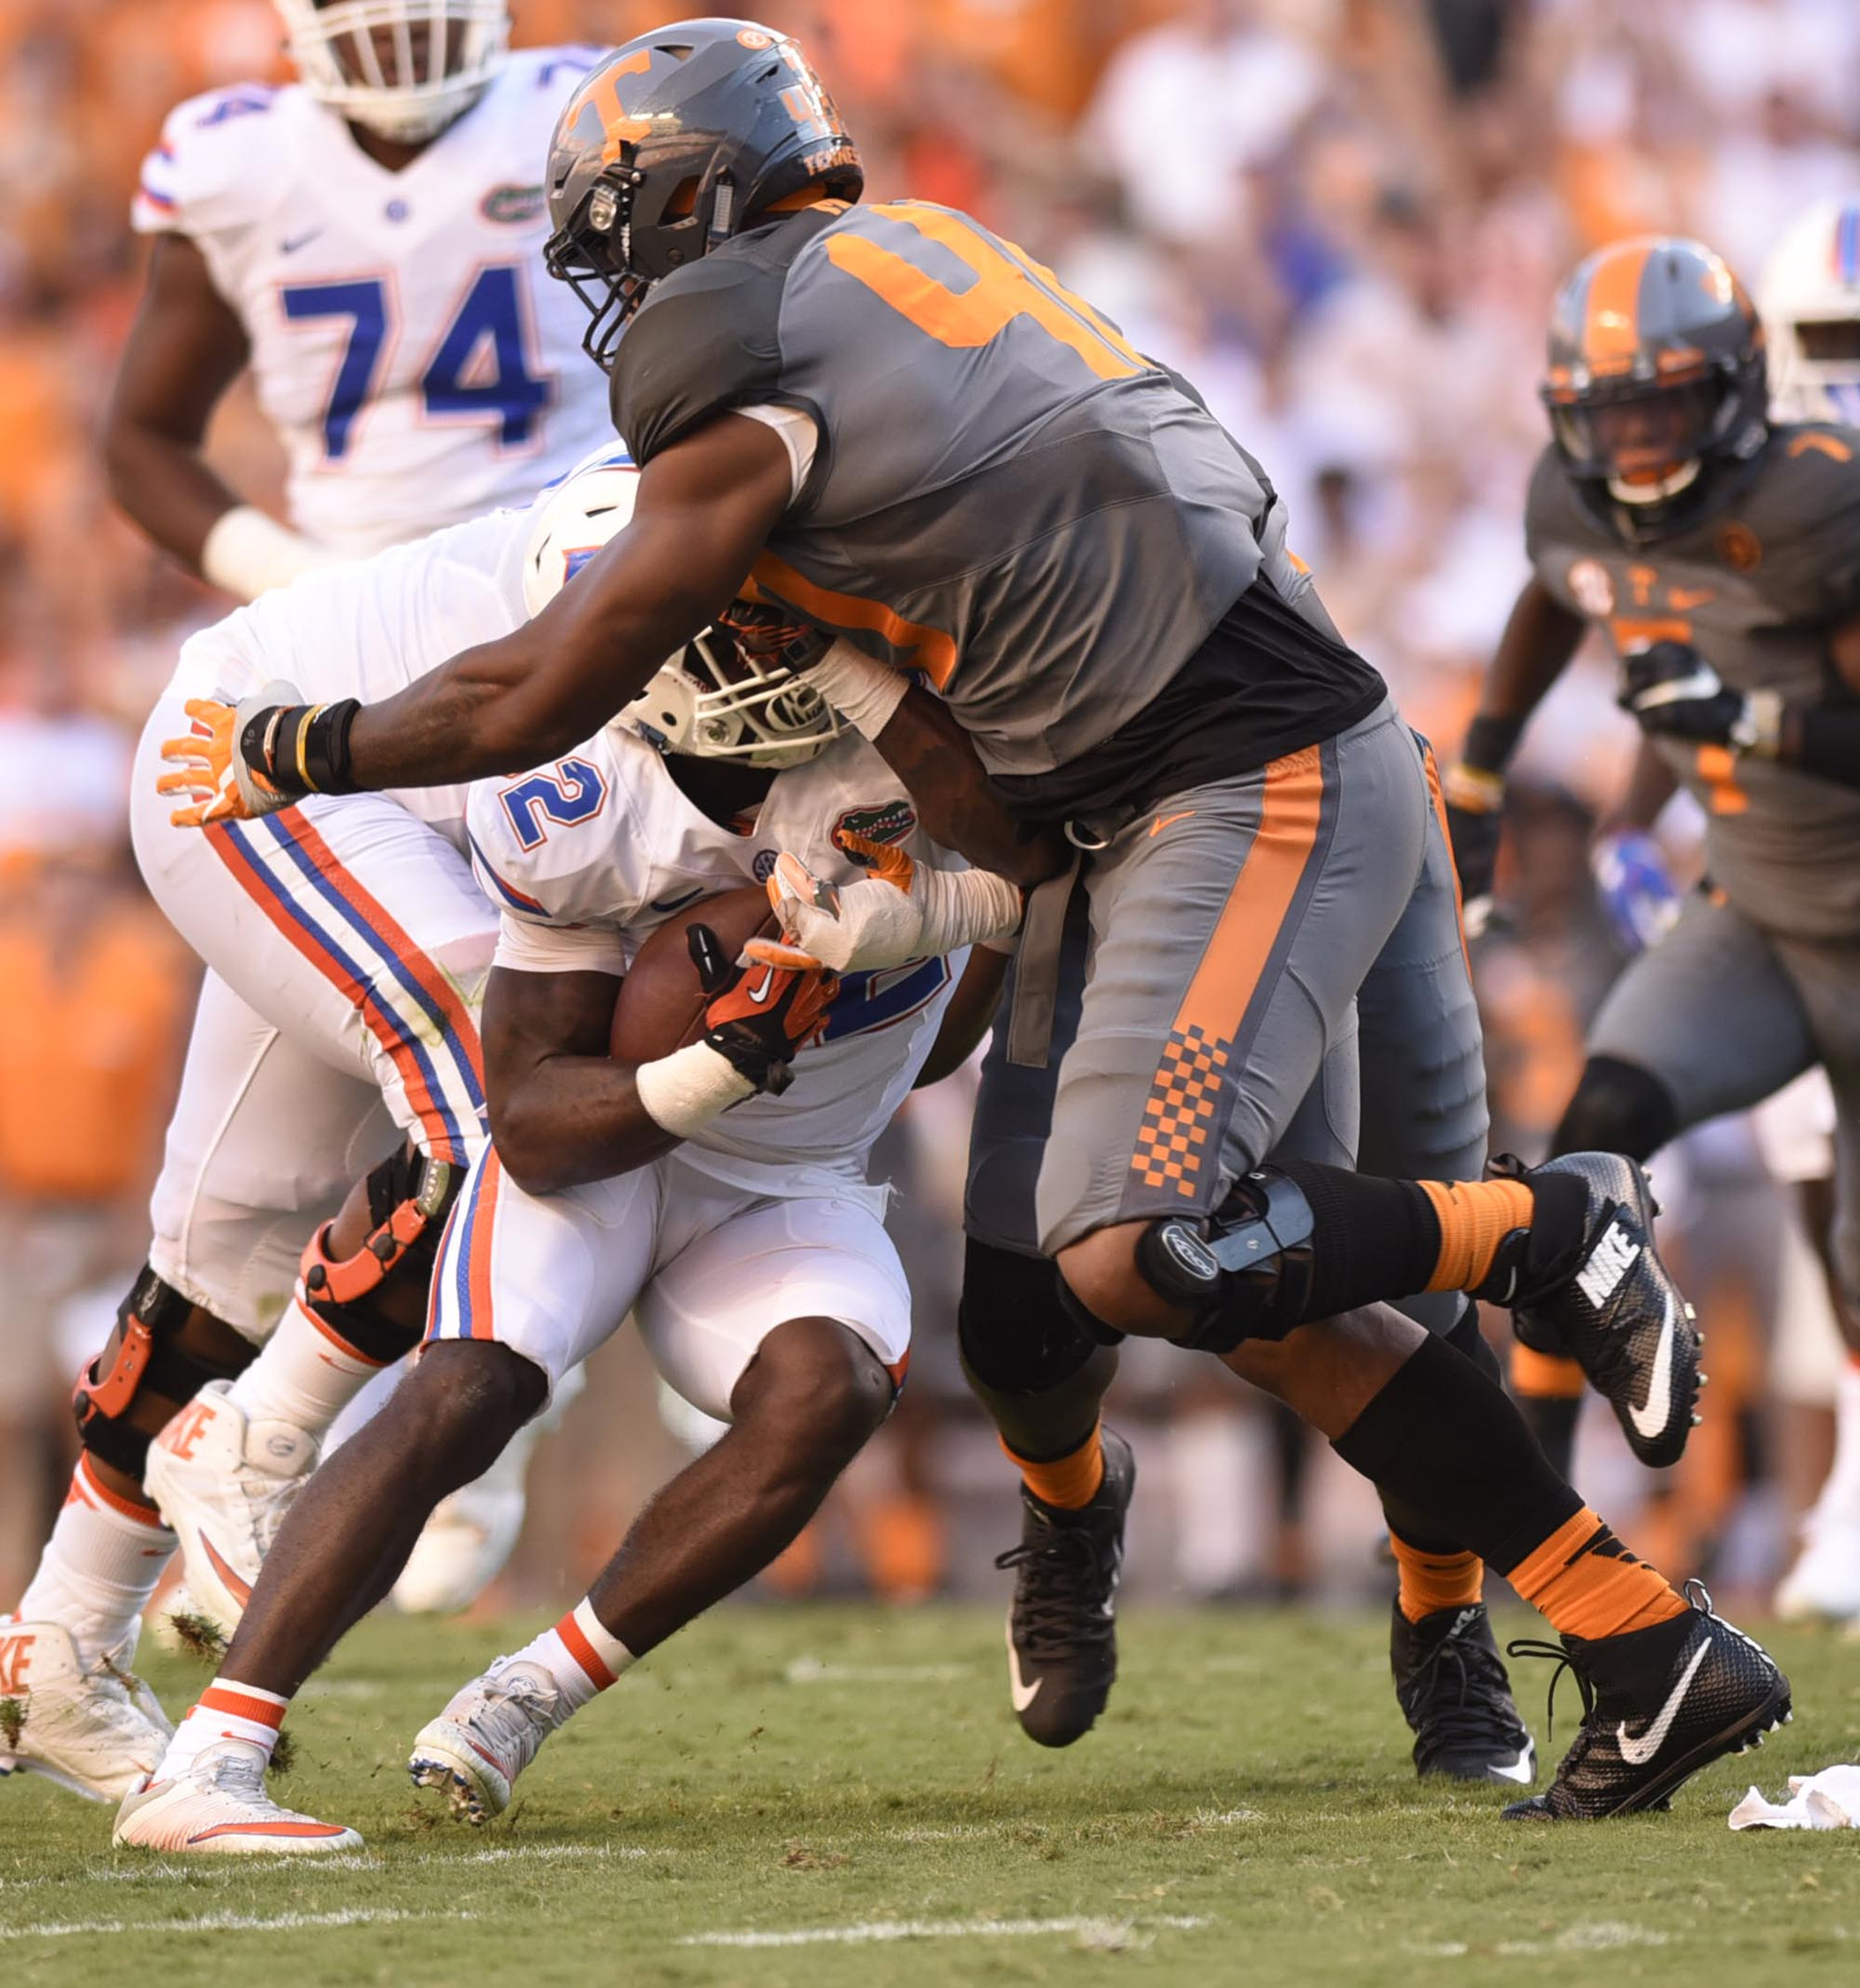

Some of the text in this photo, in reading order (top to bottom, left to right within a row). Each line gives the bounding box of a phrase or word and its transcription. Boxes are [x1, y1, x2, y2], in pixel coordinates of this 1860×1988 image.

[566, 48, 652, 164] T
[825, 199, 1158, 379] 9
[276, 260, 556, 469] 74
[1575, 1221, 1641, 1310] NIKE
